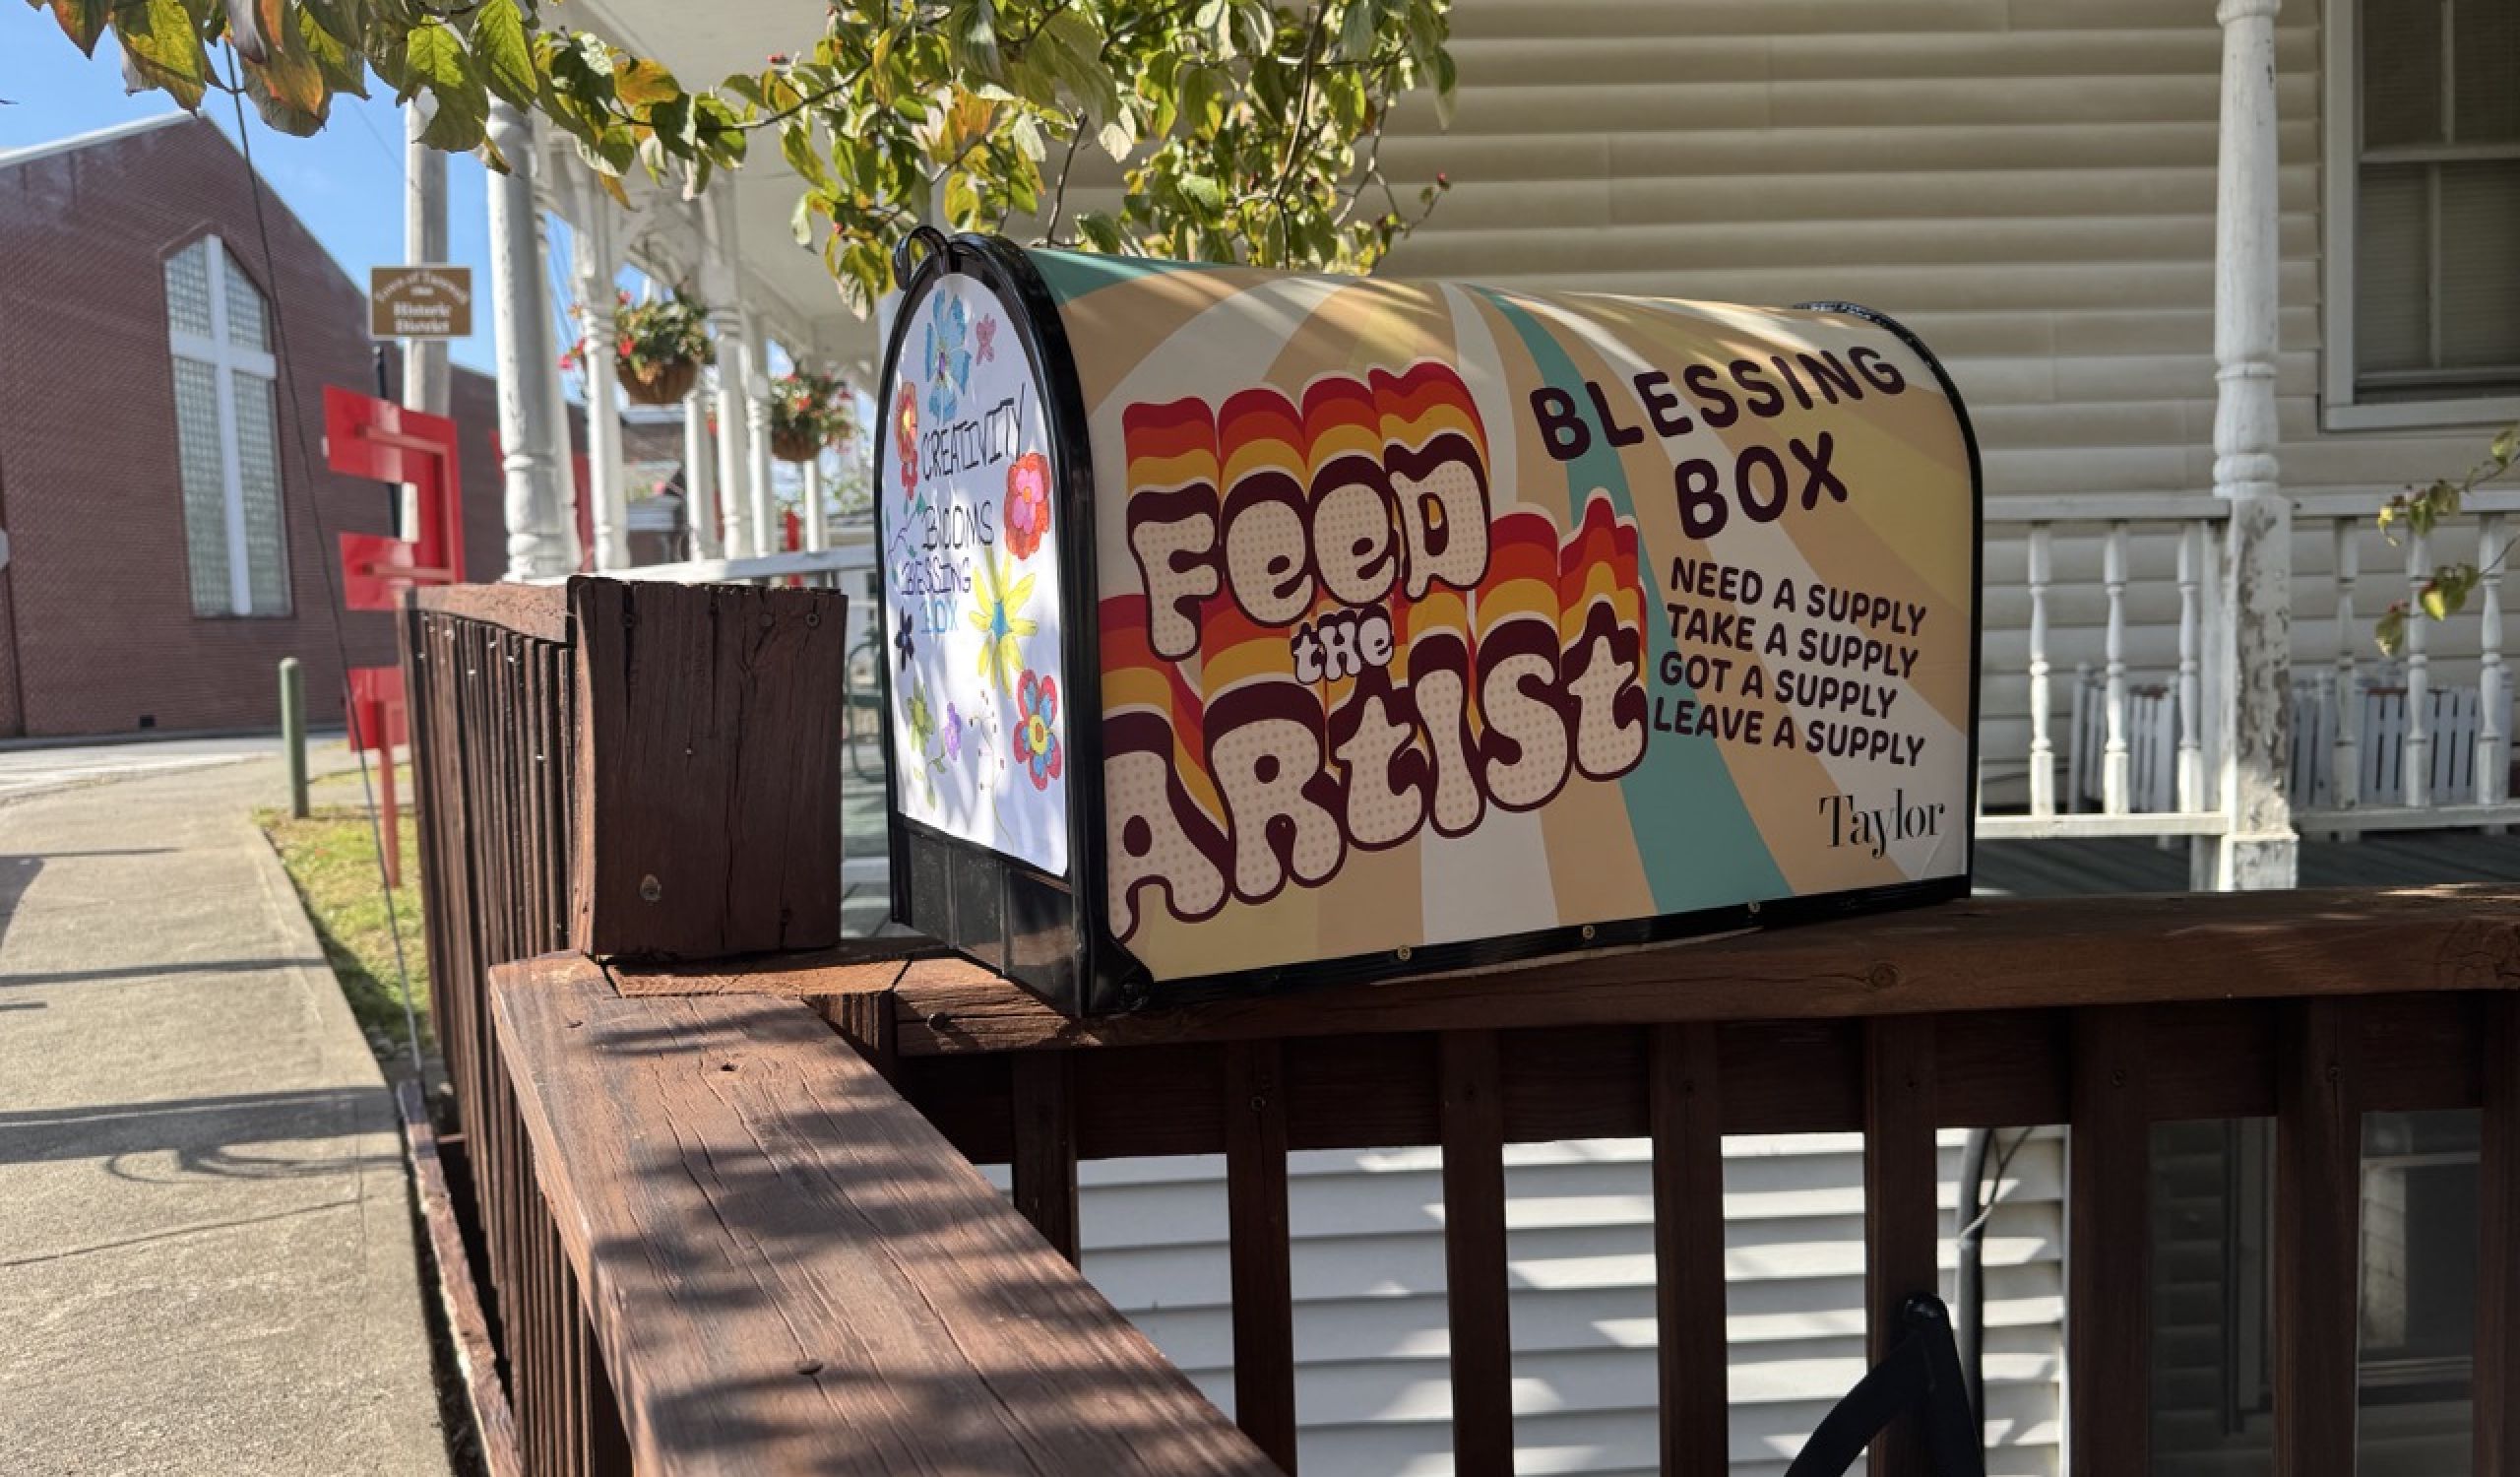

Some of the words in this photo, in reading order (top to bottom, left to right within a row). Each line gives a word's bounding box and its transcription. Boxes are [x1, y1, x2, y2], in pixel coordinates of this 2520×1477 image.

[393, 301, 450, 316] Historic
[921, 381, 1026, 481] CREATIVITY
[1529, 346, 1906, 461] BLESSING
[1674, 430, 1848, 540] BOX
[1670, 557, 1763, 605] NEED
[1774, 578, 1796, 612] A
[1806, 584, 1926, 637] SUPPLY
[1667, 603, 1756, 651] TAKE
[1765, 623, 1788, 657] A
[1798, 628, 1919, 679] SUPPLY
[1660, 651, 1732, 692] GOT
[1740, 665, 1764, 699] A
[1775, 670, 1897, 719] SUPPLY
[1654, 697, 1763, 744] LEAVE
[1774, 716, 1796, 749] A
[1805, 722, 1925, 767] SUPPLY
[1818, 789, 1945, 859] Taylor
